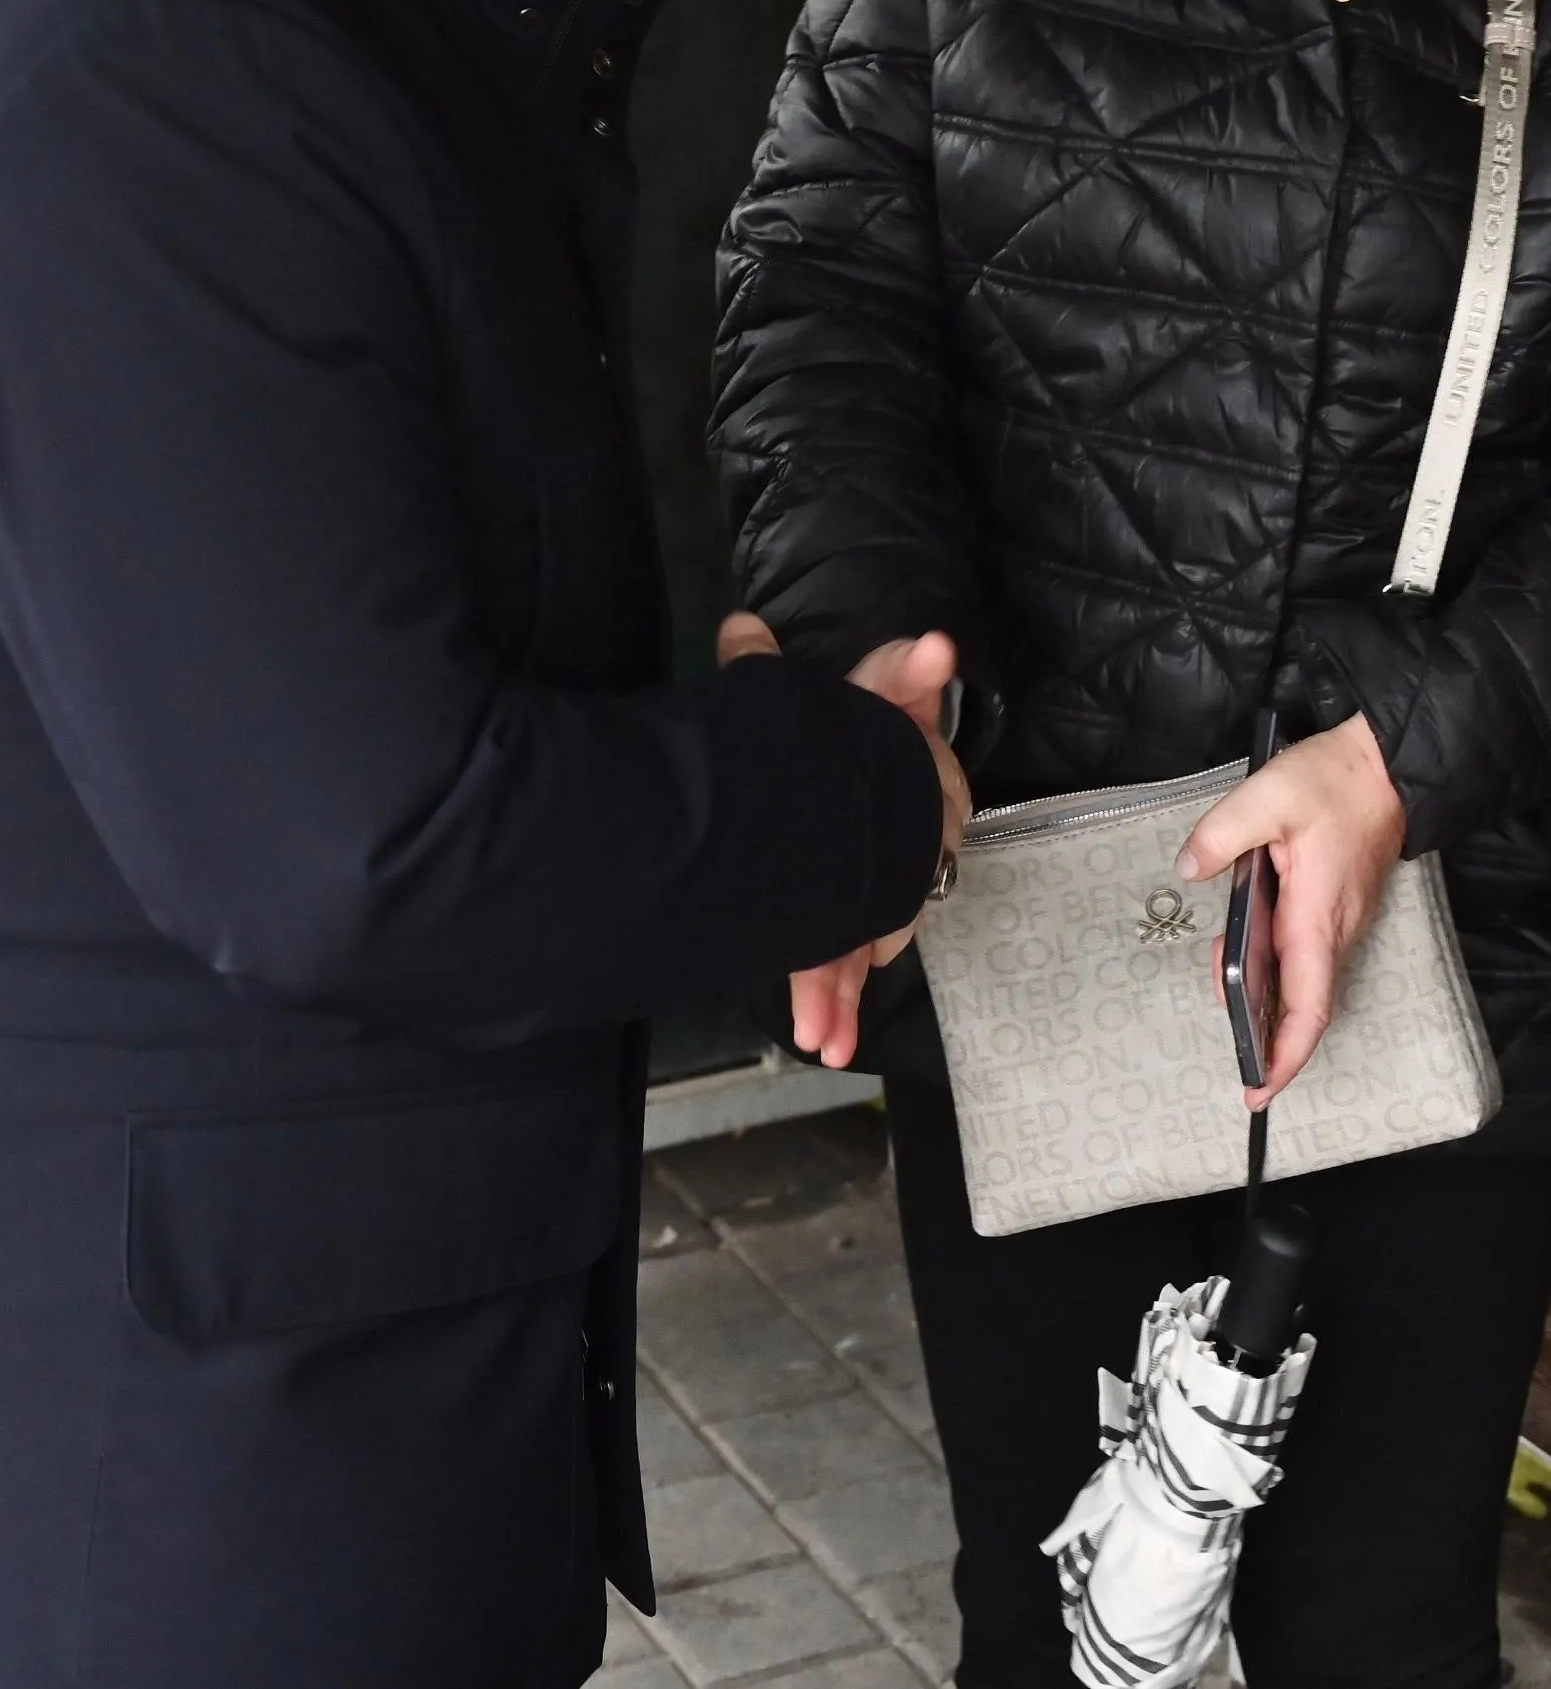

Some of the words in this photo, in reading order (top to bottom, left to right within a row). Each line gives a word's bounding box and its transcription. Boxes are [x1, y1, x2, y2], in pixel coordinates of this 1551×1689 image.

[1476, 120, 1515, 275] COLORS
[1499, 65, 1520, 111] OF
[1081, 836, 1145, 875] OF
[1090, 991, 1157, 1033] OF
[1080, 1123, 1148, 1167] OF
